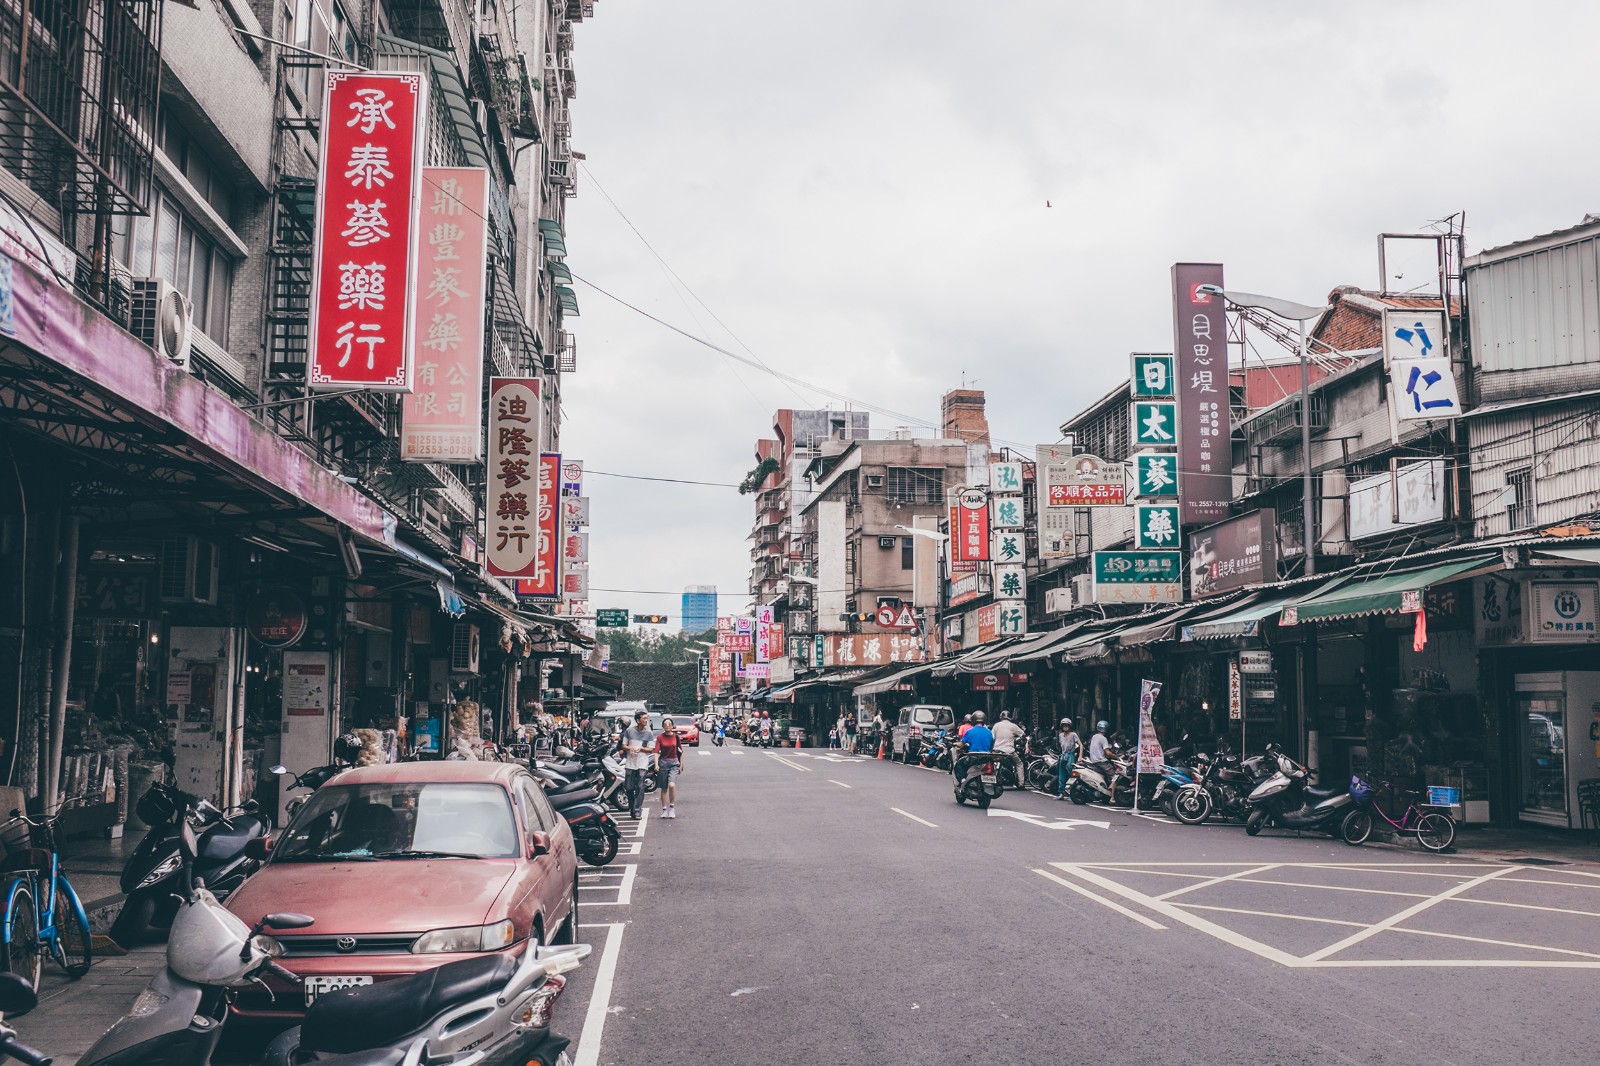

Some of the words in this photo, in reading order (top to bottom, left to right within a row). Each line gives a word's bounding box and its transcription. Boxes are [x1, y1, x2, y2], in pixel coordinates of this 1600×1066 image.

[336, 89, 395, 369] 承泰蔘藥行
[968, 511, 981, 557] 卡瓦咖啡
[900, 615, 910, 624] 慢
